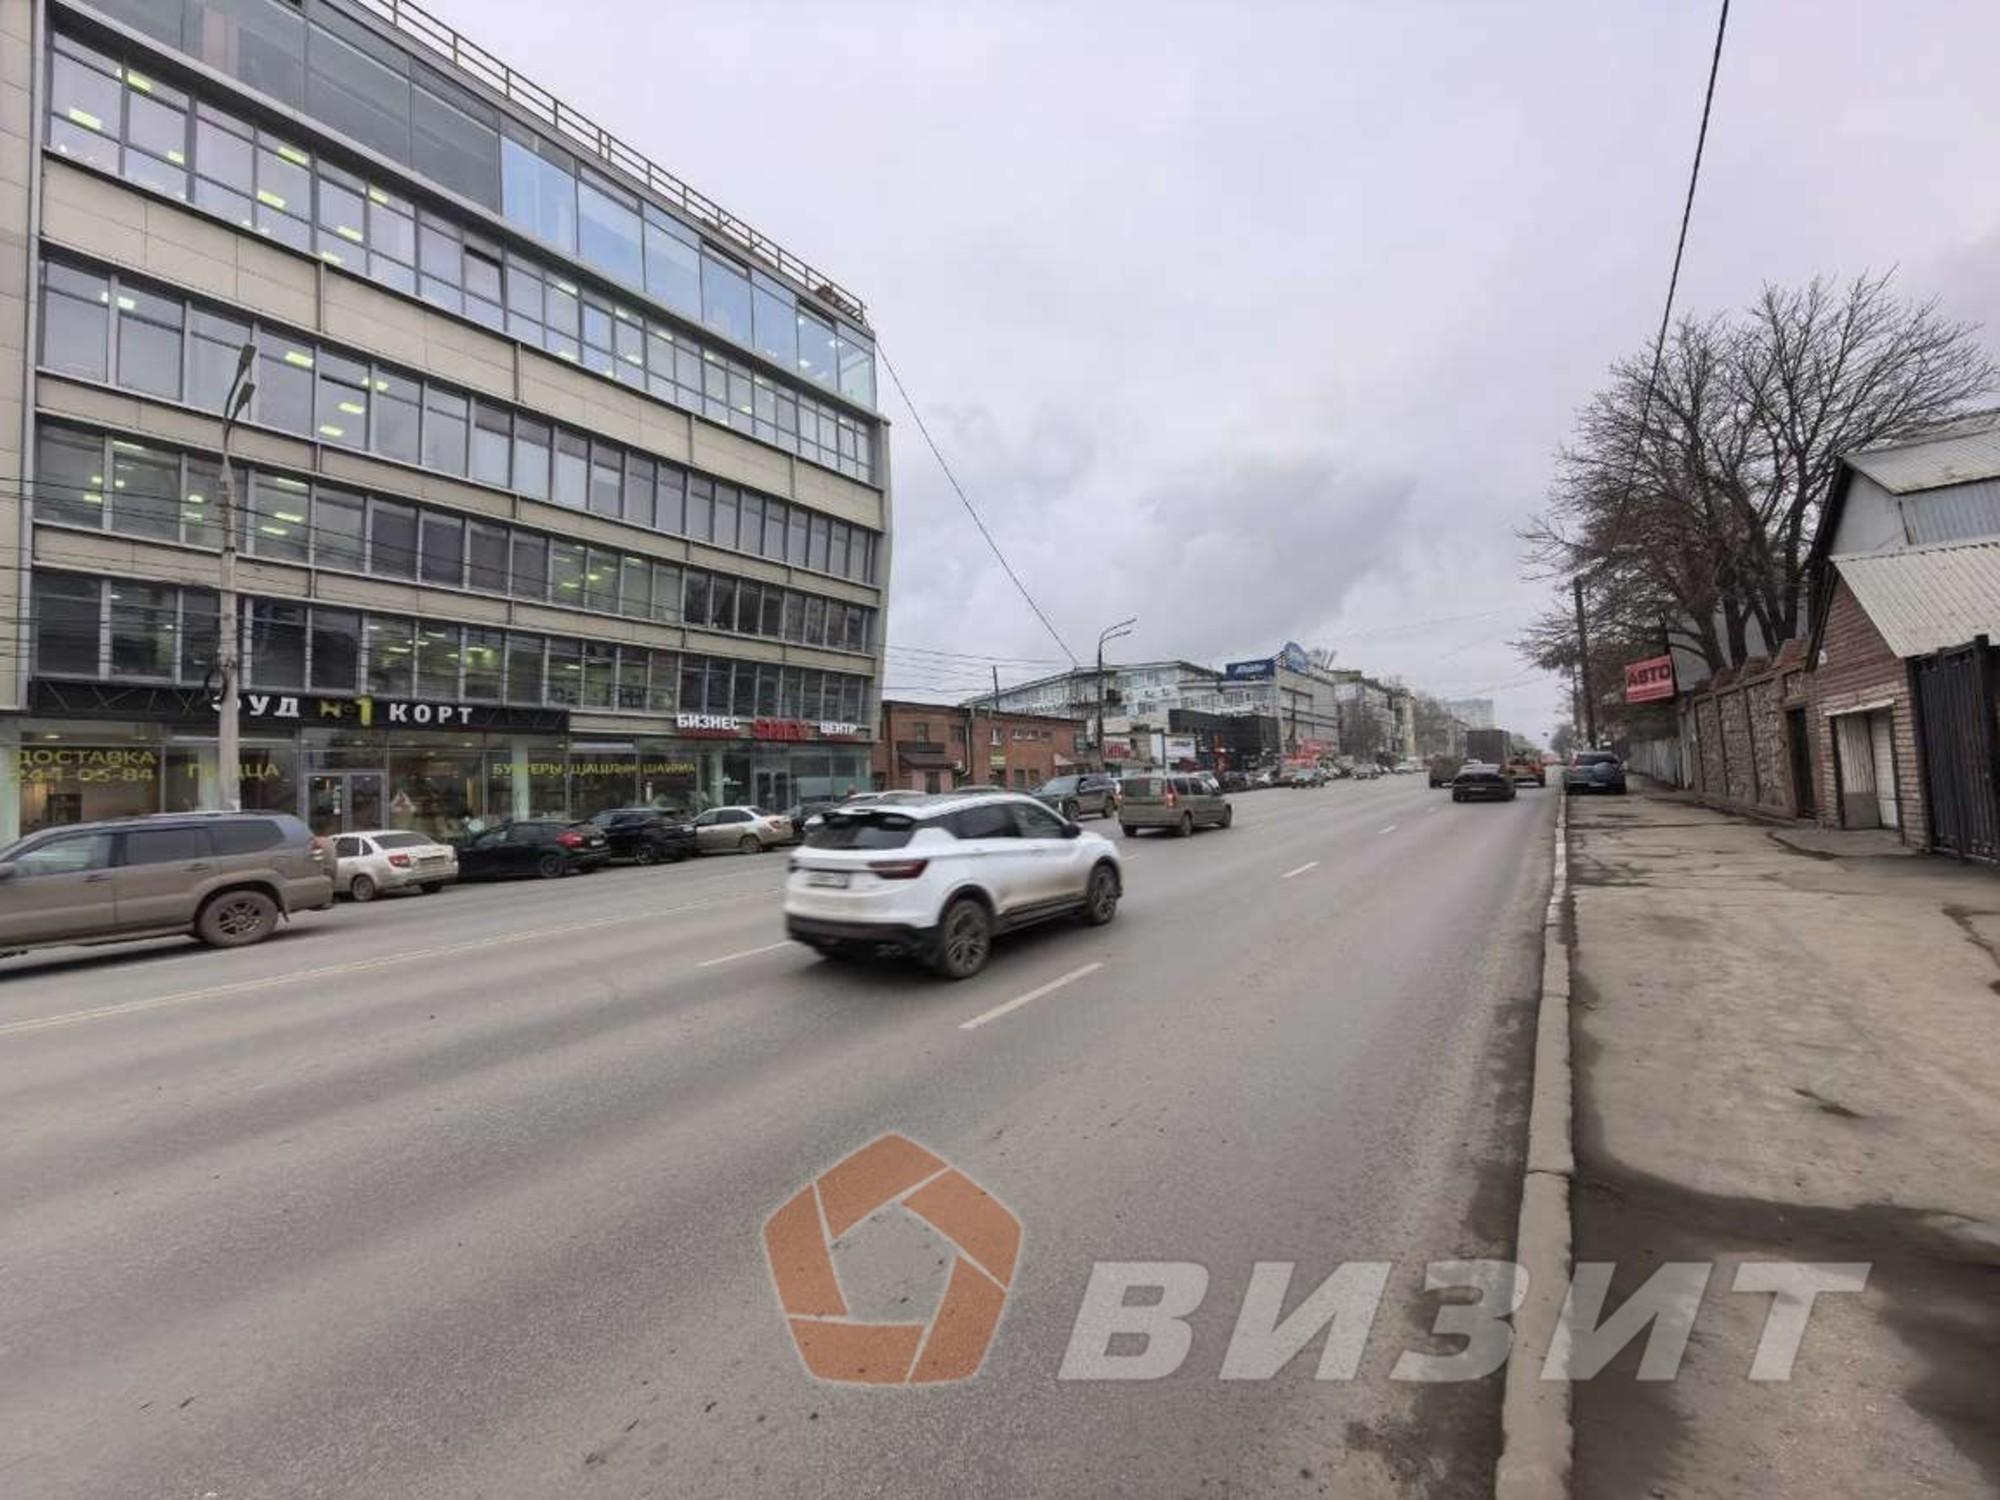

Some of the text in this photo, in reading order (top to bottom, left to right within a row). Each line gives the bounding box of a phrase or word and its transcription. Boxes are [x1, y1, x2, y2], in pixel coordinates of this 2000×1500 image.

[388, 702, 473, 725] КОРТ
[676, 713, 740, 731] БИЗНЕС
[15, 749, 157, 767] ДОСТАВКА
[188, 762, 280, 781] ПЦА
